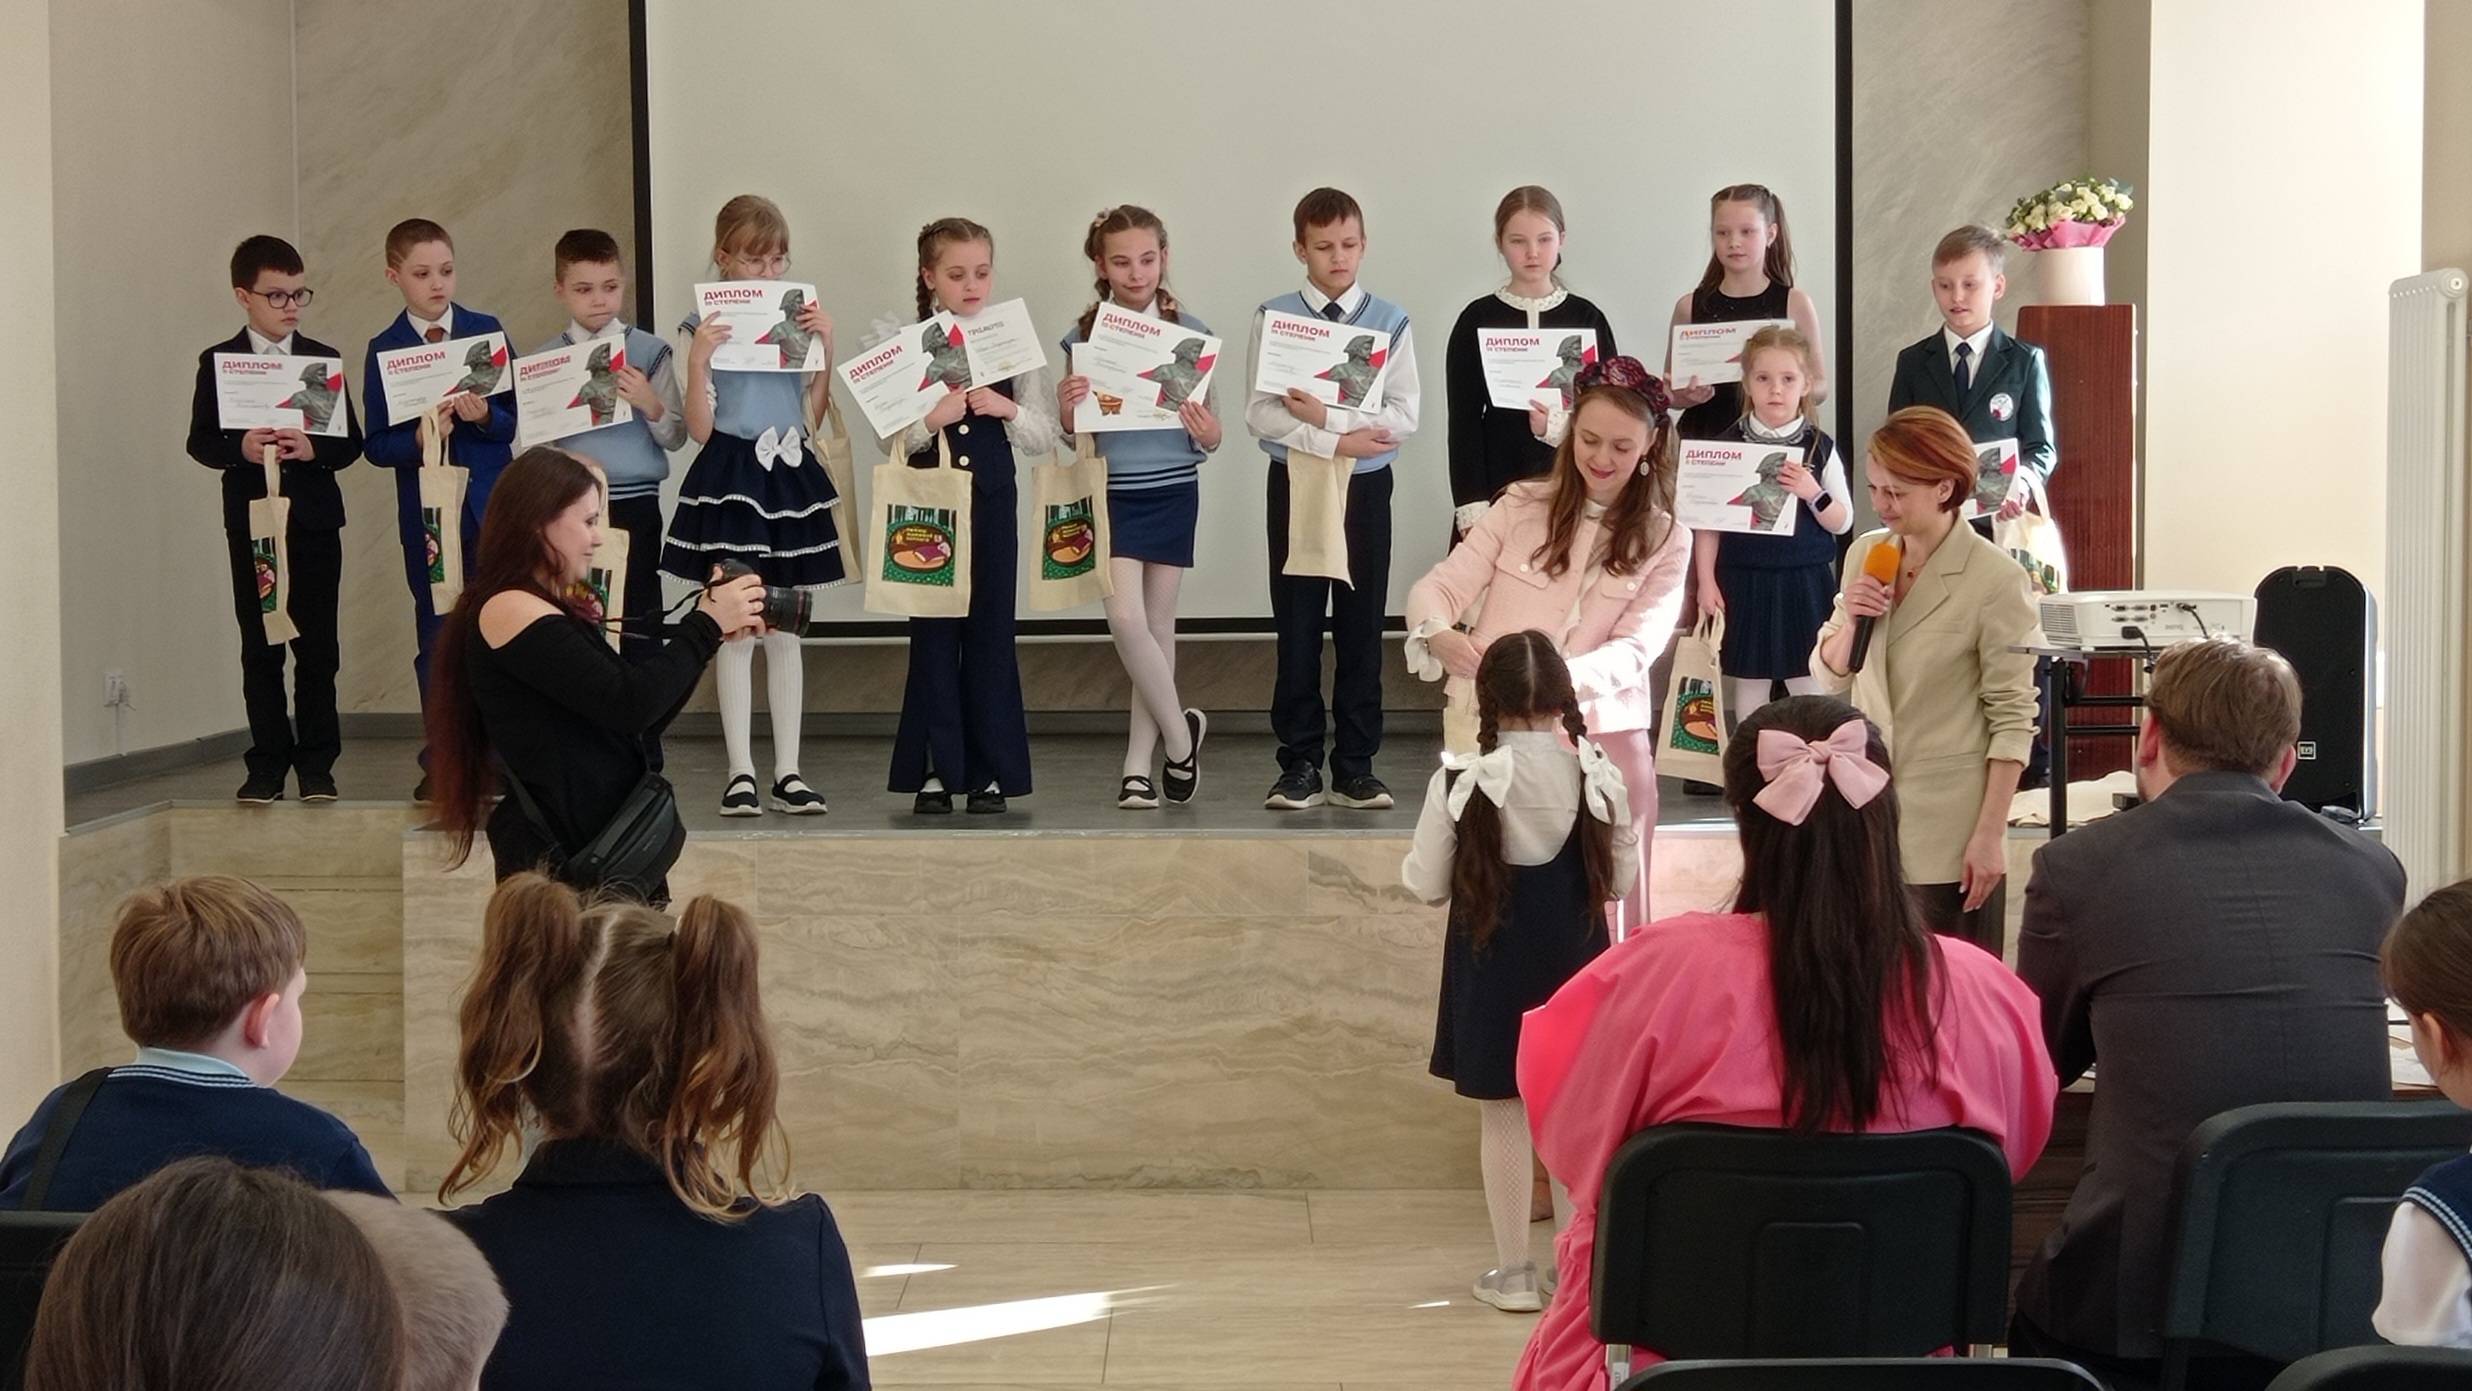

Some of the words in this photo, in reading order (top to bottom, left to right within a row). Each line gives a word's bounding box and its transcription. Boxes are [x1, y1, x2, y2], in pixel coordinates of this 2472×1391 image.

[704, 289, 763, 300] ДИПЛОМ
[1102, 313, 1161, 336] ДИПЛОМ
[1272, 320, 1330, 338] ДИПЛОМ
[1485, 337, 1540, 346] ДИПЛОМ
[222, 361, 283, 370] ДИПЛОМ
[386, 351, 446, 370] ДИПЛОМ
[849, 345, 903, 380] ДИПЛОМ
[1685, 450, 1742, 460] ДИПЛОМ
